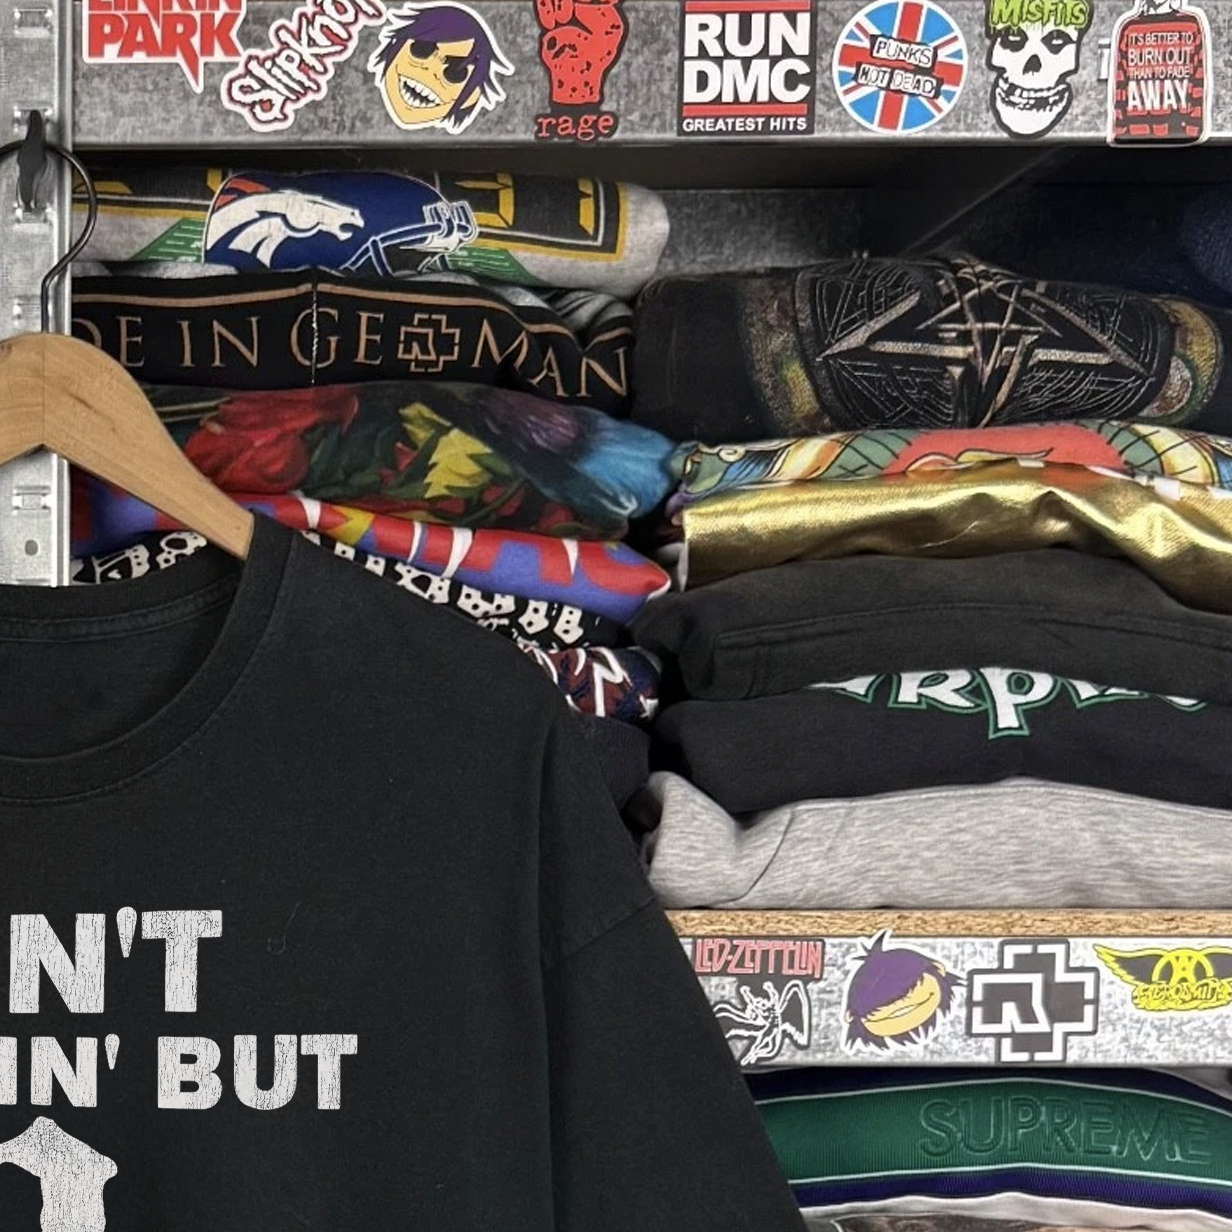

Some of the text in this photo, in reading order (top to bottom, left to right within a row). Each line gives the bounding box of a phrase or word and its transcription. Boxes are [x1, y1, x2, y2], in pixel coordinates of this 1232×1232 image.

[88, 13, 243, 84] PARK
[683, 13, 810, 57] RUN
[1146, 32, 1179, 45] BETTER
[1180, 32, 1194, 44] TO
[875, 39, 933, 66] PUNKS
[1128, 47, 1164, 66] BURN
[1165, 46, 1194, 64] OUT
[683, 60, 811, 103] DMC
[858, 65, 936, 95] NOT DEAD
[1129, 65, 1191, 79] THAN TO FADE
[1128, 79, 1189, 111] AWAY
[537, 113, 617, 141] rage
[682, 117, 807, 132] GREATEST HITS
[177, 316, 259, 367] IN
[157, 1034, 359, 1110] BUT
[918, 1095, 1212, 1164] SUPREME
